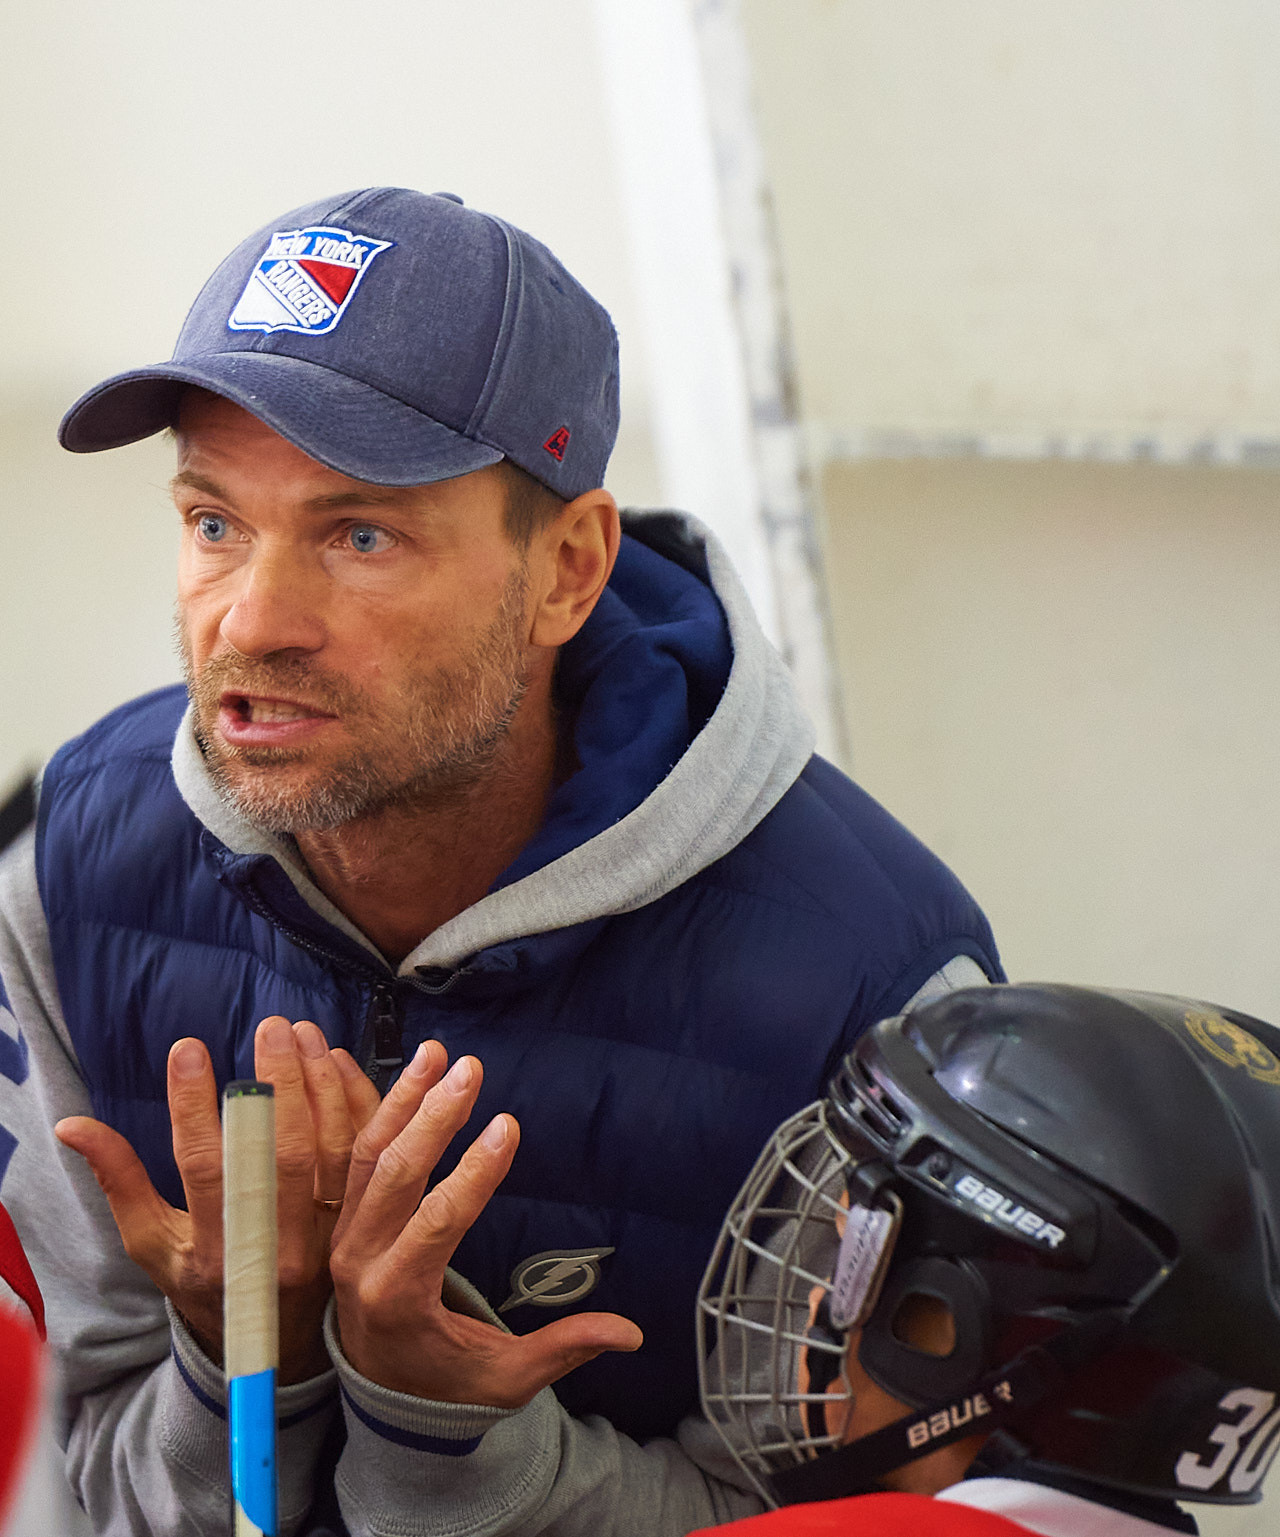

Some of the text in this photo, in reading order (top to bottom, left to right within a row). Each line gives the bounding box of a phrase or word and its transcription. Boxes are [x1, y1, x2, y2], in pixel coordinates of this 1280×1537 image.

[270, 236, 369, 266] NEW YORK
[264, 260, 332, 326] RANGERS
[1174, 1387, 1280, 1495] 30
